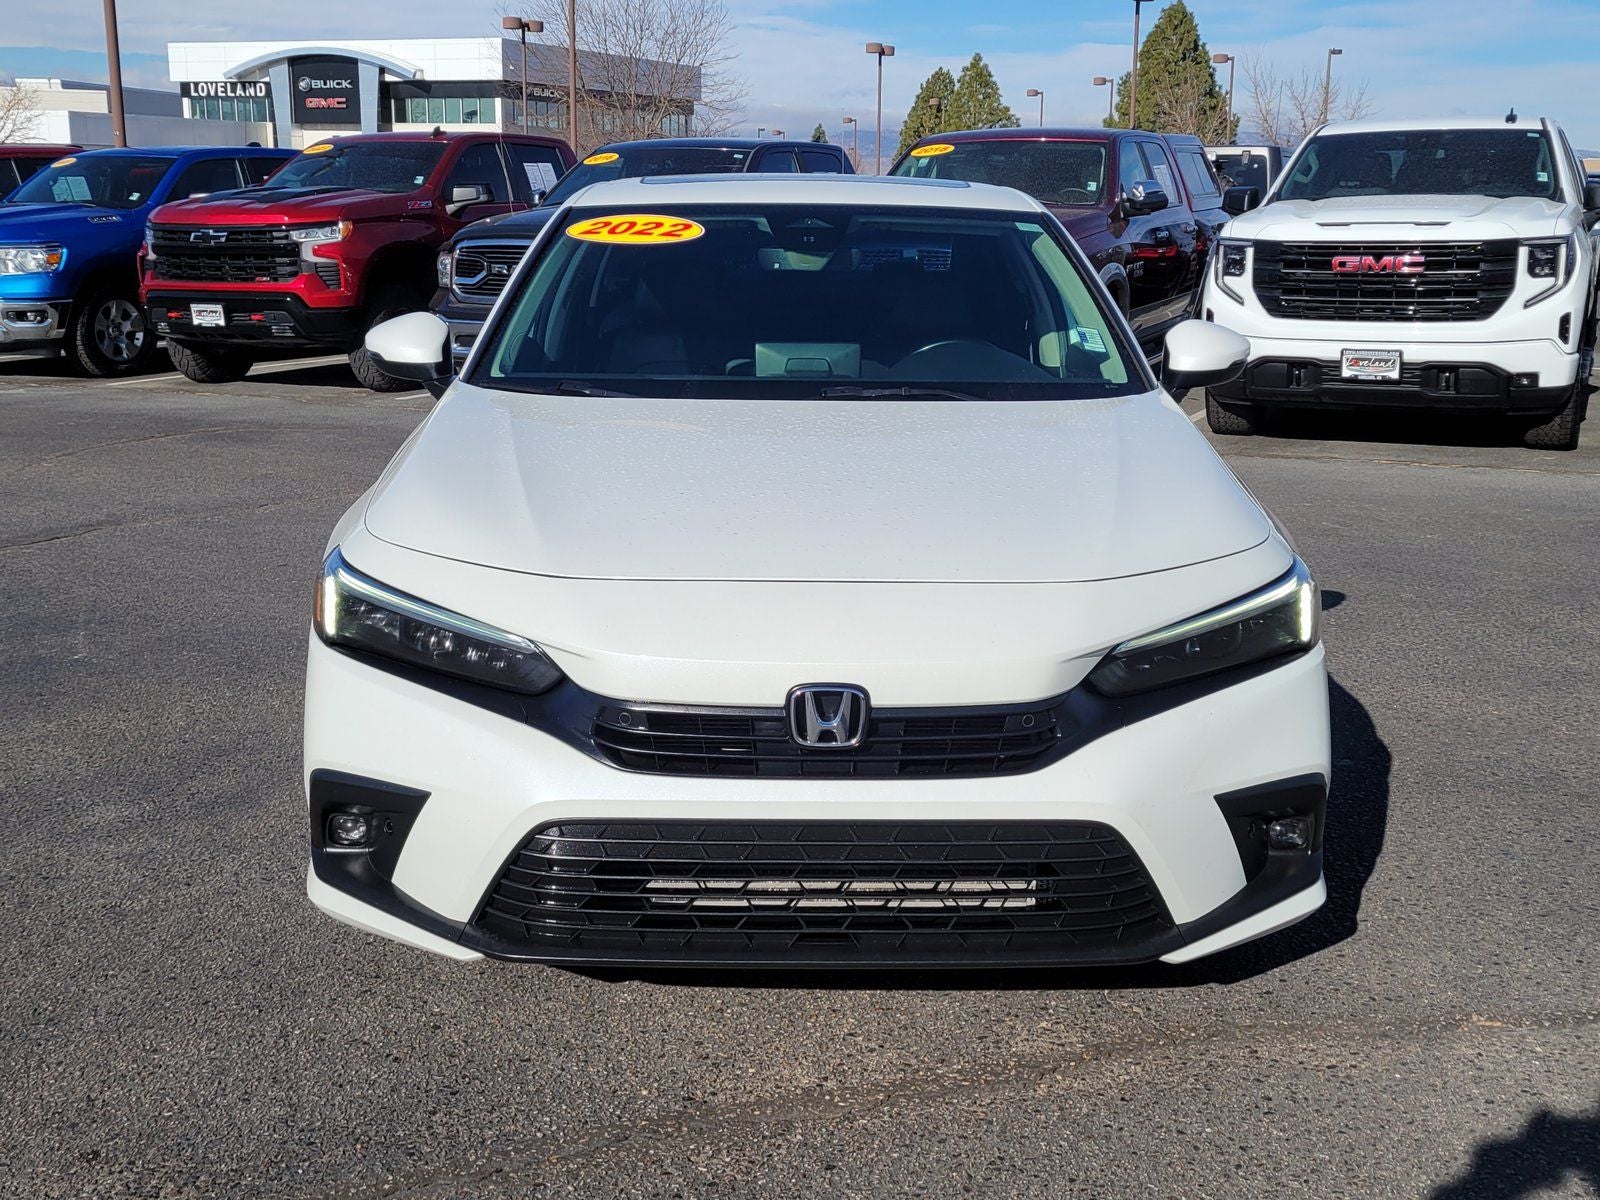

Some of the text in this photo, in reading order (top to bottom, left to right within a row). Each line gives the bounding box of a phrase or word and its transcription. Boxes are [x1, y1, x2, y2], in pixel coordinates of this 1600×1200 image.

[190, 83, 266, 97] LOVELAND
[311, 79, 352, 89] BUICK
[533, 88, 565, 99] BUICK
[305, 97, 347, 108] GMC
[579, 220, 693, 238] 2022
[1331, 255, 1424, 273] GMC
